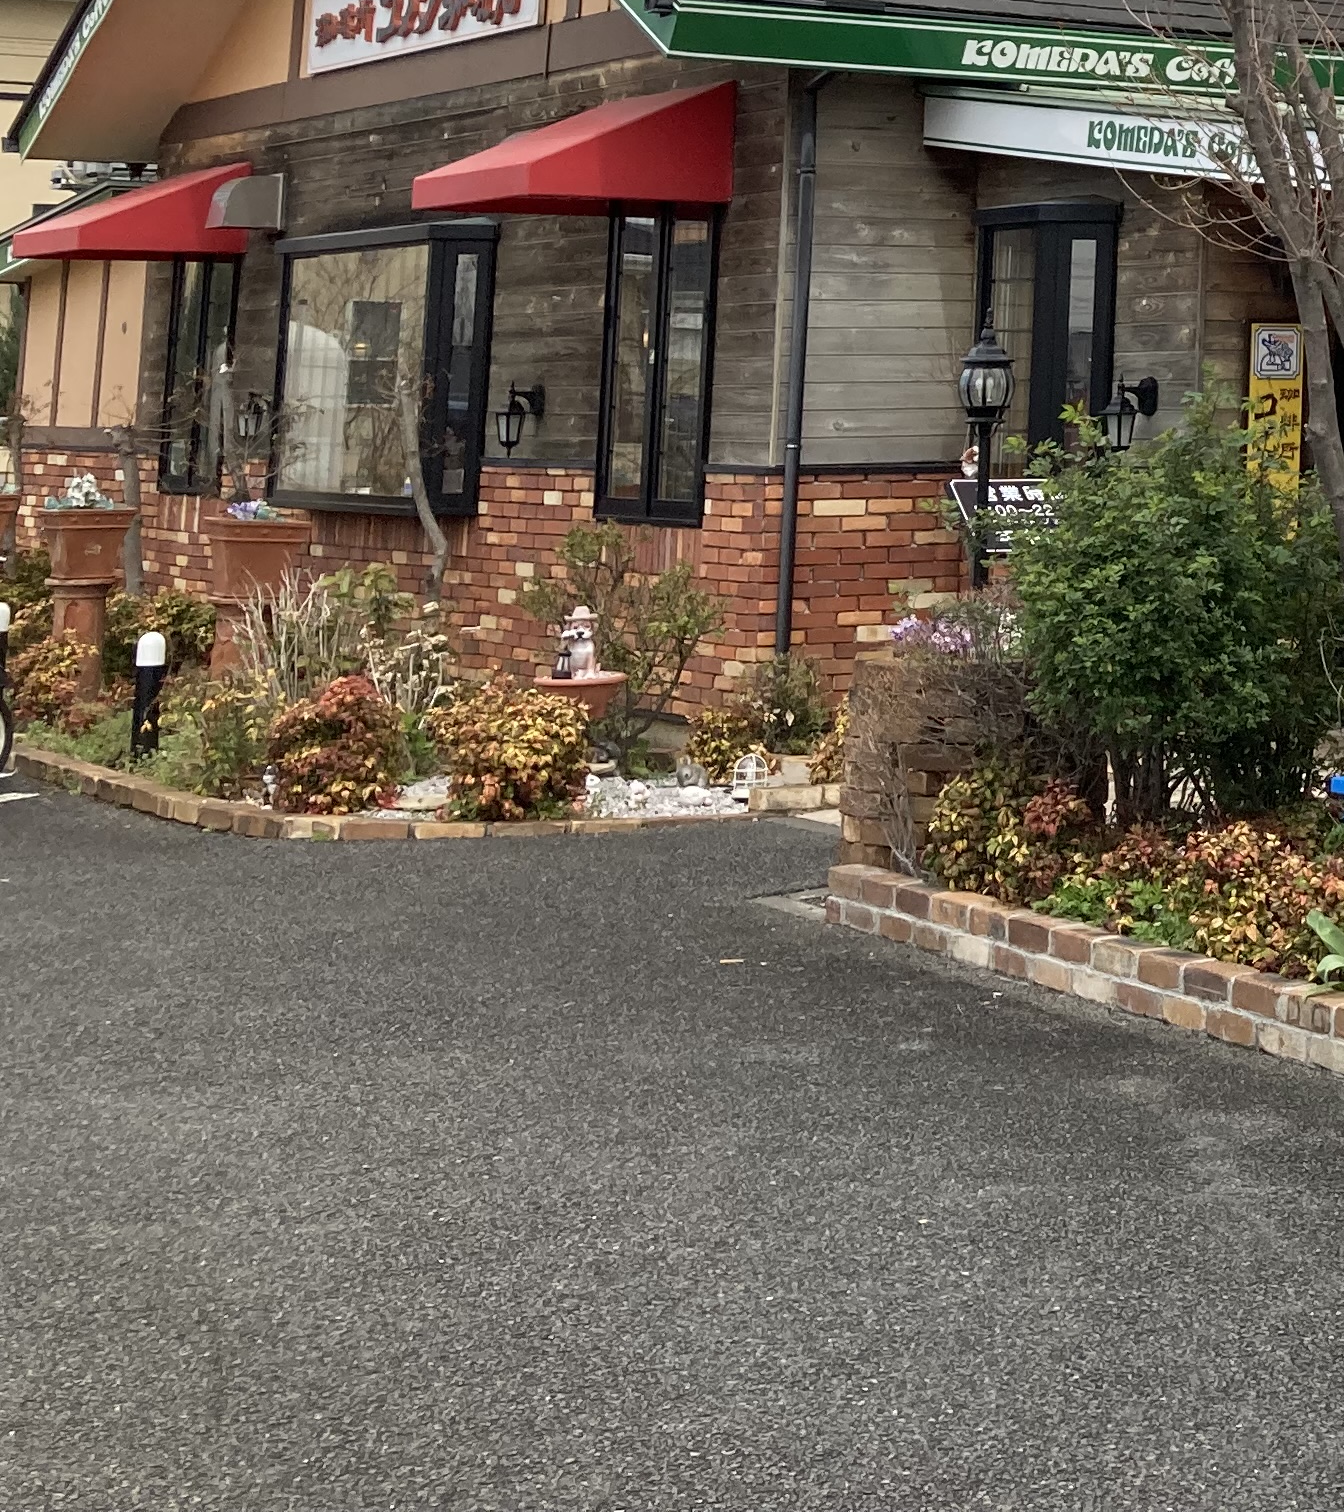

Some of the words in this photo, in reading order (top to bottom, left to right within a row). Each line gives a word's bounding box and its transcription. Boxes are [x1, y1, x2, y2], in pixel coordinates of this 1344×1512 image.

[961, 39, 1154, 78] KOMEDA'S
[1165, 54, 1238, 85] Coff
[1086, 120, 1199, 159] KOMEDA'S
